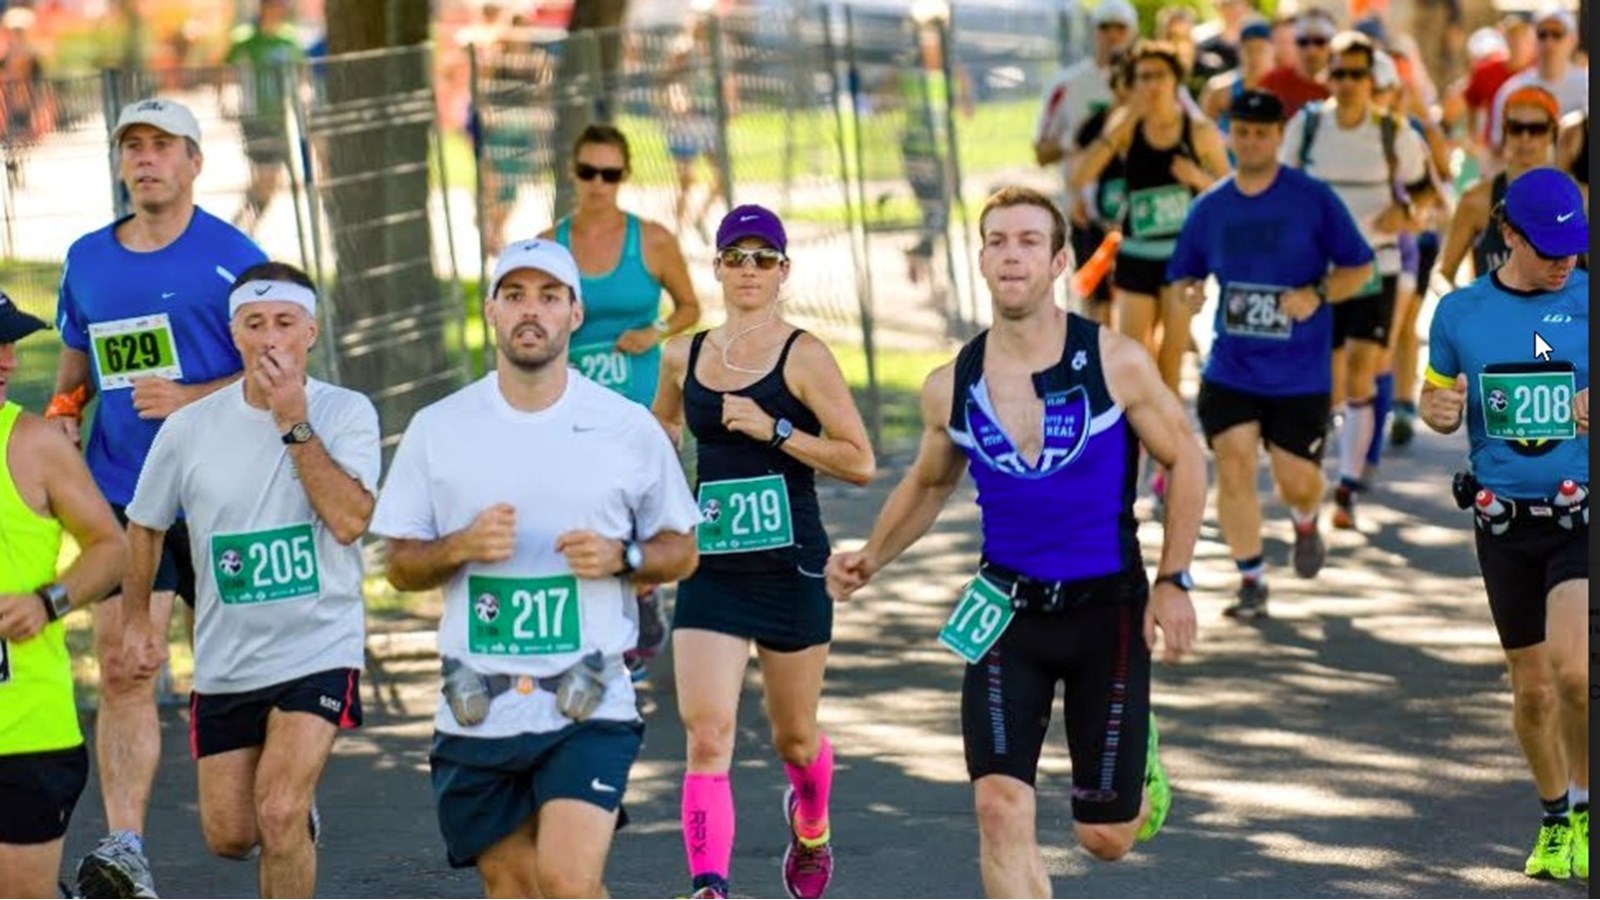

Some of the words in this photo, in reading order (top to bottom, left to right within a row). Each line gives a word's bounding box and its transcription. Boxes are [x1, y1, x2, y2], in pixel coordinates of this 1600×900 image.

[104, 332, 161, 372] 629
[1514, 384, 1571, 424] 208
[729, 489, 781, 535] 219
[248, 535, 314, 587] 205
[512, 588, 569, 639] 217
